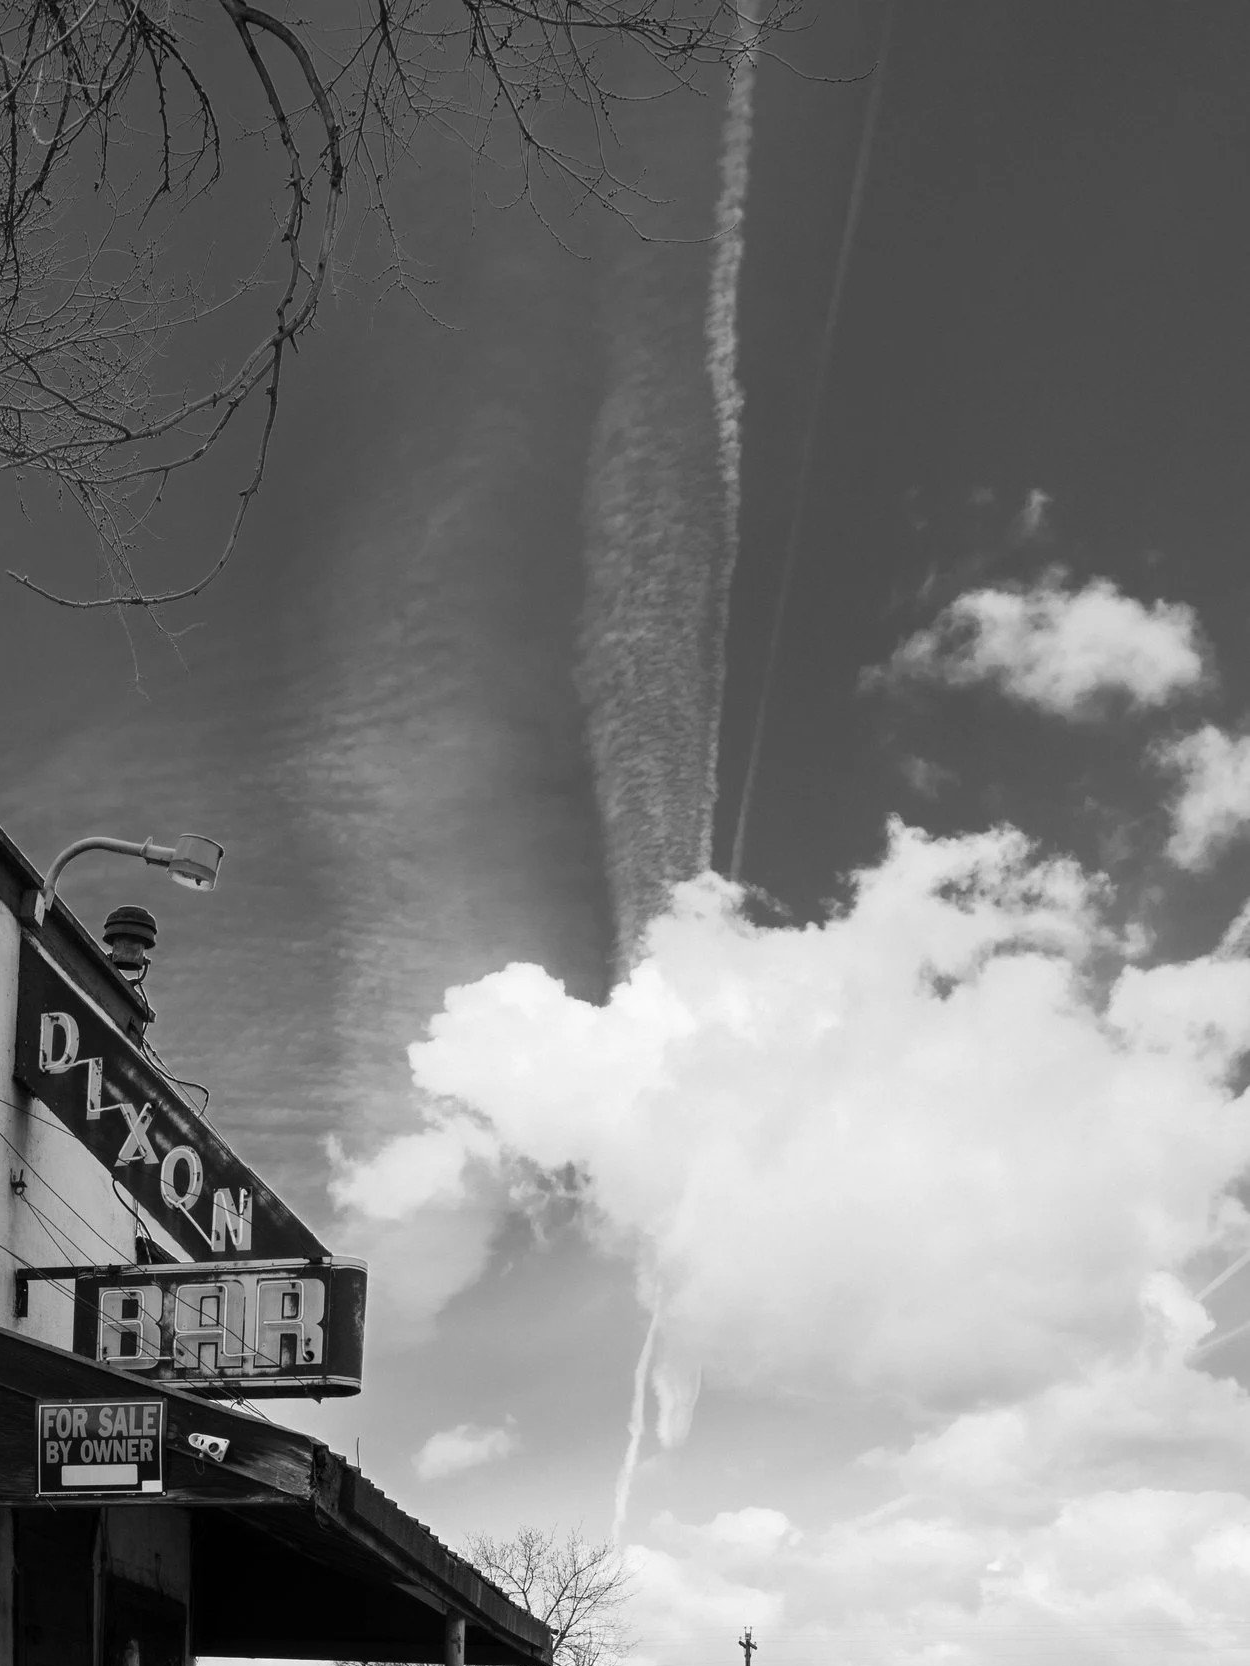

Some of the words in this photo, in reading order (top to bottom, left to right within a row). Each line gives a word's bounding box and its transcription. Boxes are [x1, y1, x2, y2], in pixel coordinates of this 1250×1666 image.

[39, 1012, 252, 1252] DIXON
[96, 1277, 325, 1370] BAR
[43, 1407, 88, 1439] FOR
[98, 1405, 158, 1438] SALE
[45, 1440, 74, 1464] BY
[80, 1438, 154, 1463] OWNER
